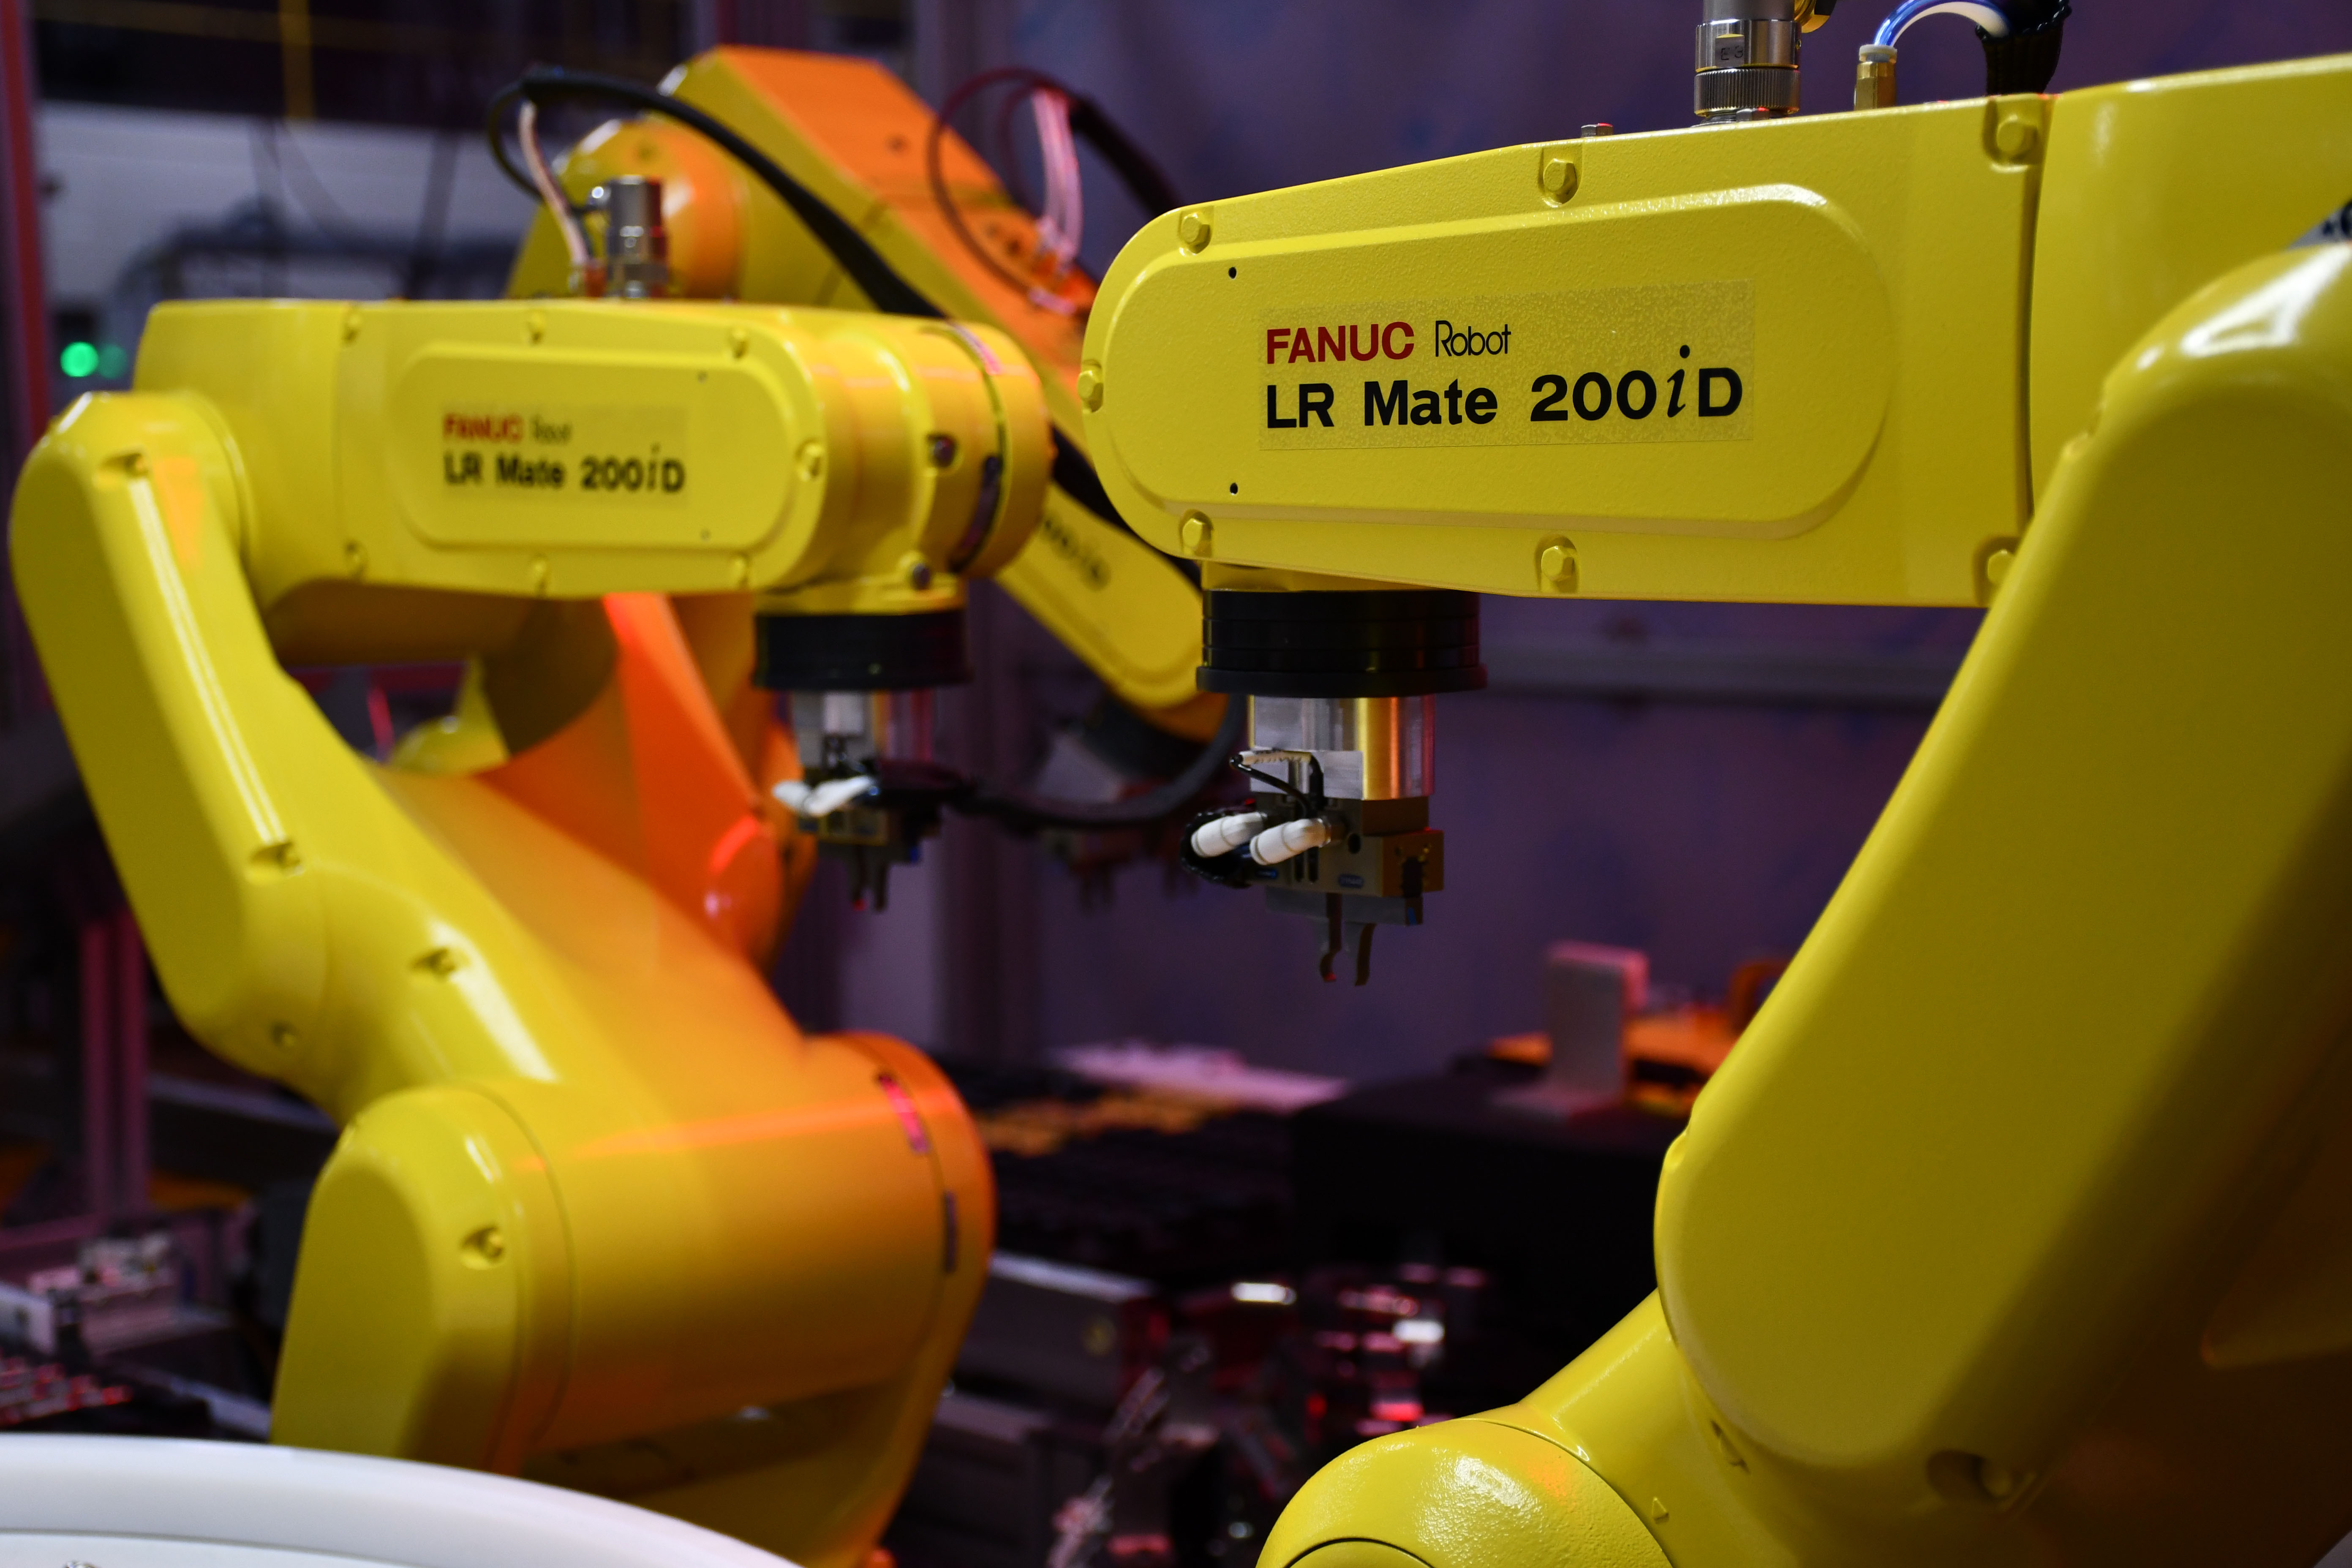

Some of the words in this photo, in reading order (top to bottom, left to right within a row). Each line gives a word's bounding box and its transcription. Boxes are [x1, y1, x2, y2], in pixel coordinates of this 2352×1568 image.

[1267, 321, 1414, 365] FANUC
[1435, 320, 1512, 357] Robot
[1267, 382, 1335, 429] LR
[1364, 378, 1498, 426] Mate
[1530, 344, 1743, 422] 200iD
[580, 442, 685, 493] 200iD
